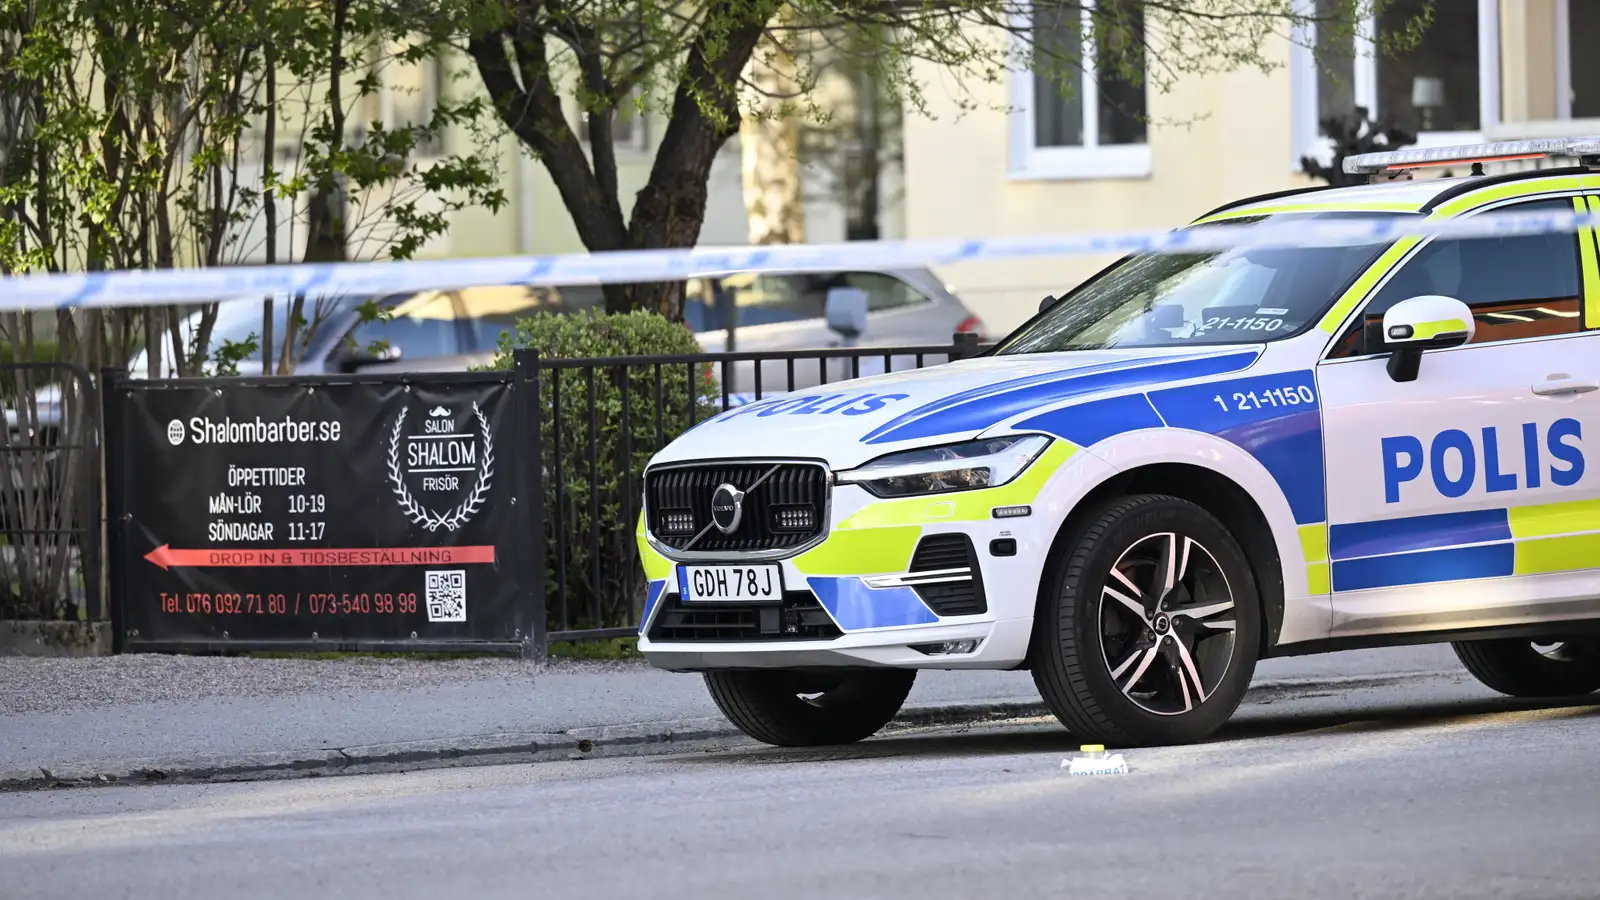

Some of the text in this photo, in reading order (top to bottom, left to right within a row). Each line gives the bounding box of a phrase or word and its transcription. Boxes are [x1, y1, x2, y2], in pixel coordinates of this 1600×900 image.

[1203, 317, 1283, 331] 21-1150
[716, 393, 910, 422] POLIS
[1214, 385, 1314, 412] 1 21-1150
[190, 416, 340, 444] Shalombarber.se
[425, 419, 455, 434] SALON
[408, 441, 476, 467] SHALOM
[1381, 418, 1585, 504] POLIS
[228, 465, 305, 487] ÖPPETTIDER
[423, 474, 459, 491] FRISÖR
[208, 491, 326, 514] MÅN-LÖR 10-19
[208, 519, 326, 541] SÖNDAGAR 11-17
[209, 549, 452, 565] DROP IN & TIDSBESTÄLLNING
[693, 568, 772, 597] GDH 78J
[160, 592, 182, 613] Tel.
[186, 593, 211, 614] 076
[215, 593, 242, 614] 092
[246, 593, 264, 614] 71
[268, 593, 286, 614] 80
[309, 593, 370, 614] 073-540
[374, 593, 394, 614] 98
[398, 592, 417, 614] 98
